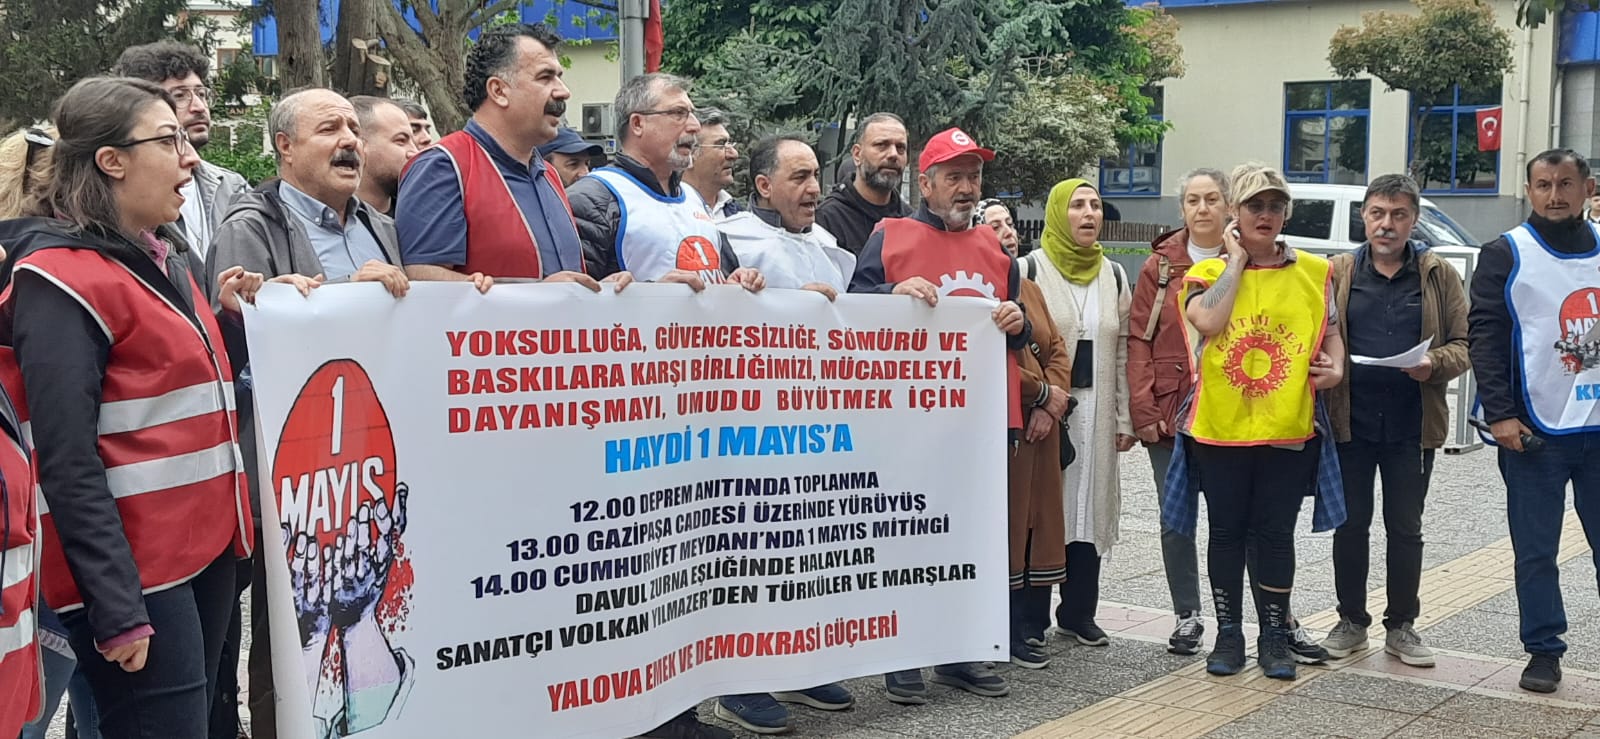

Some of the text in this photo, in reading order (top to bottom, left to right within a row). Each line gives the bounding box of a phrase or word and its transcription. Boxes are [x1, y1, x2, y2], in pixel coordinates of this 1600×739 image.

[693, 241, 709, 267] 1
[1586, 291, 1599, 316] 1
[446, 325, 968, 357] YOKSULLUĞA, GÜVENCESİZLİĞE, SÖMÜRÜ VE
[1275, 323, 1306, 355] SEN
[448, 353, 967, 395] BASKILARA KARŞI BİRLİĞİMİZİ, MÜCADELEYİ,
[330, 376, 344, 456] 1
[448, 384, 966, 433] DAYANIŞMAYI, UMUDU BÜYÜTMEK İÇİN
[605, 423, 854, 474] HAYDİ 1 MAYIS'A
[281, 457, 386, 537] MAYIS
[569, 471, 879, 523] 12.00 DEPREM ANITINDA TOPLANMA
[506, 492, 927, 562] 13.00 GAZİPAŞA CADDESİ ÜZERİNDE YÜRÜYÜŞ
[471, 515, 950, 598] 14.00 CUMHURİYET MEYDANI'NDA 1 MAYIS MİTİNGİ
[576, 547, 876, 614] DAVUL ZURNA EŞLİĞİNDE HALAYLAR
[436, 563, 977, 671] SANATÇI VOLKAN YILMAZER'DEN TÜRKÜLER VE MARŞLAR
[546, 609, 899, 713] YALOVA EMEK VE DEMOKRASİ GÜÇLERİ
